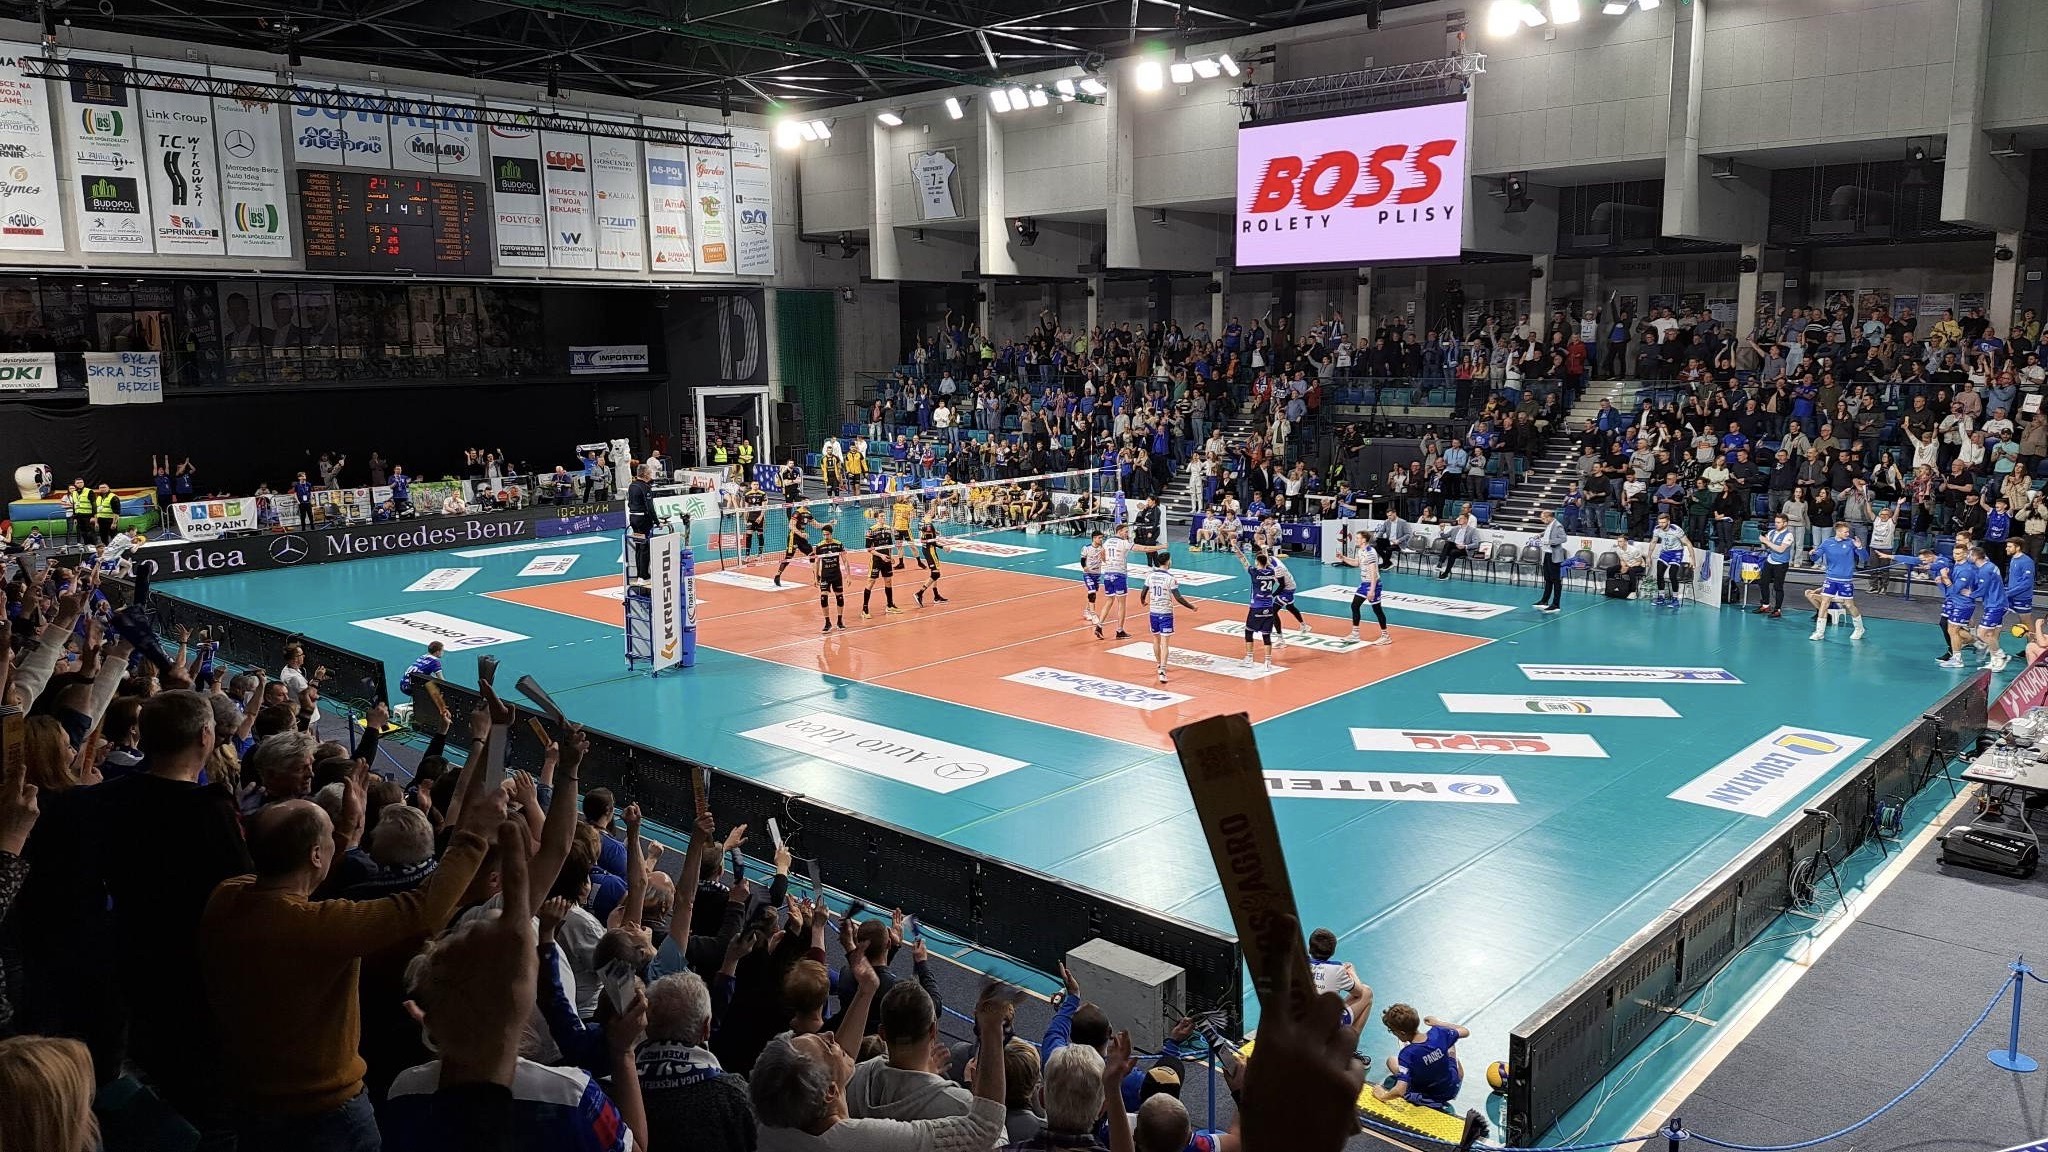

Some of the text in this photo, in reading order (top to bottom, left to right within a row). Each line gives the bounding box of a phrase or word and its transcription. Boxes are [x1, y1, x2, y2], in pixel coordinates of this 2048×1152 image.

[145, 109, 170, 120] Link
[172, 112, 208, 125] Group
[1242, 138, 1458, 214] BOSS
[578, 190, 589, 198] NA
[1242, 205, 1455, 233] ROLETY PLISY
[159, 228, 212, 237] SPRINKLER
[121, 352, 158, 365] BYŁA
[88, 365, 159, 378] SKRA JEST
[117, 381, 161, 393] BĘDZIE
[187, 518, 248, 533] PRO-PAINT
[326, 516, 526, 557] Mercedes-Benz
[169, 548, 247, 574] Idea
[662, 541, 674, 640] KRISPOL
[1260, 580, 1274, 592] 24
[784, 718, 943, 765] Auto Idea
